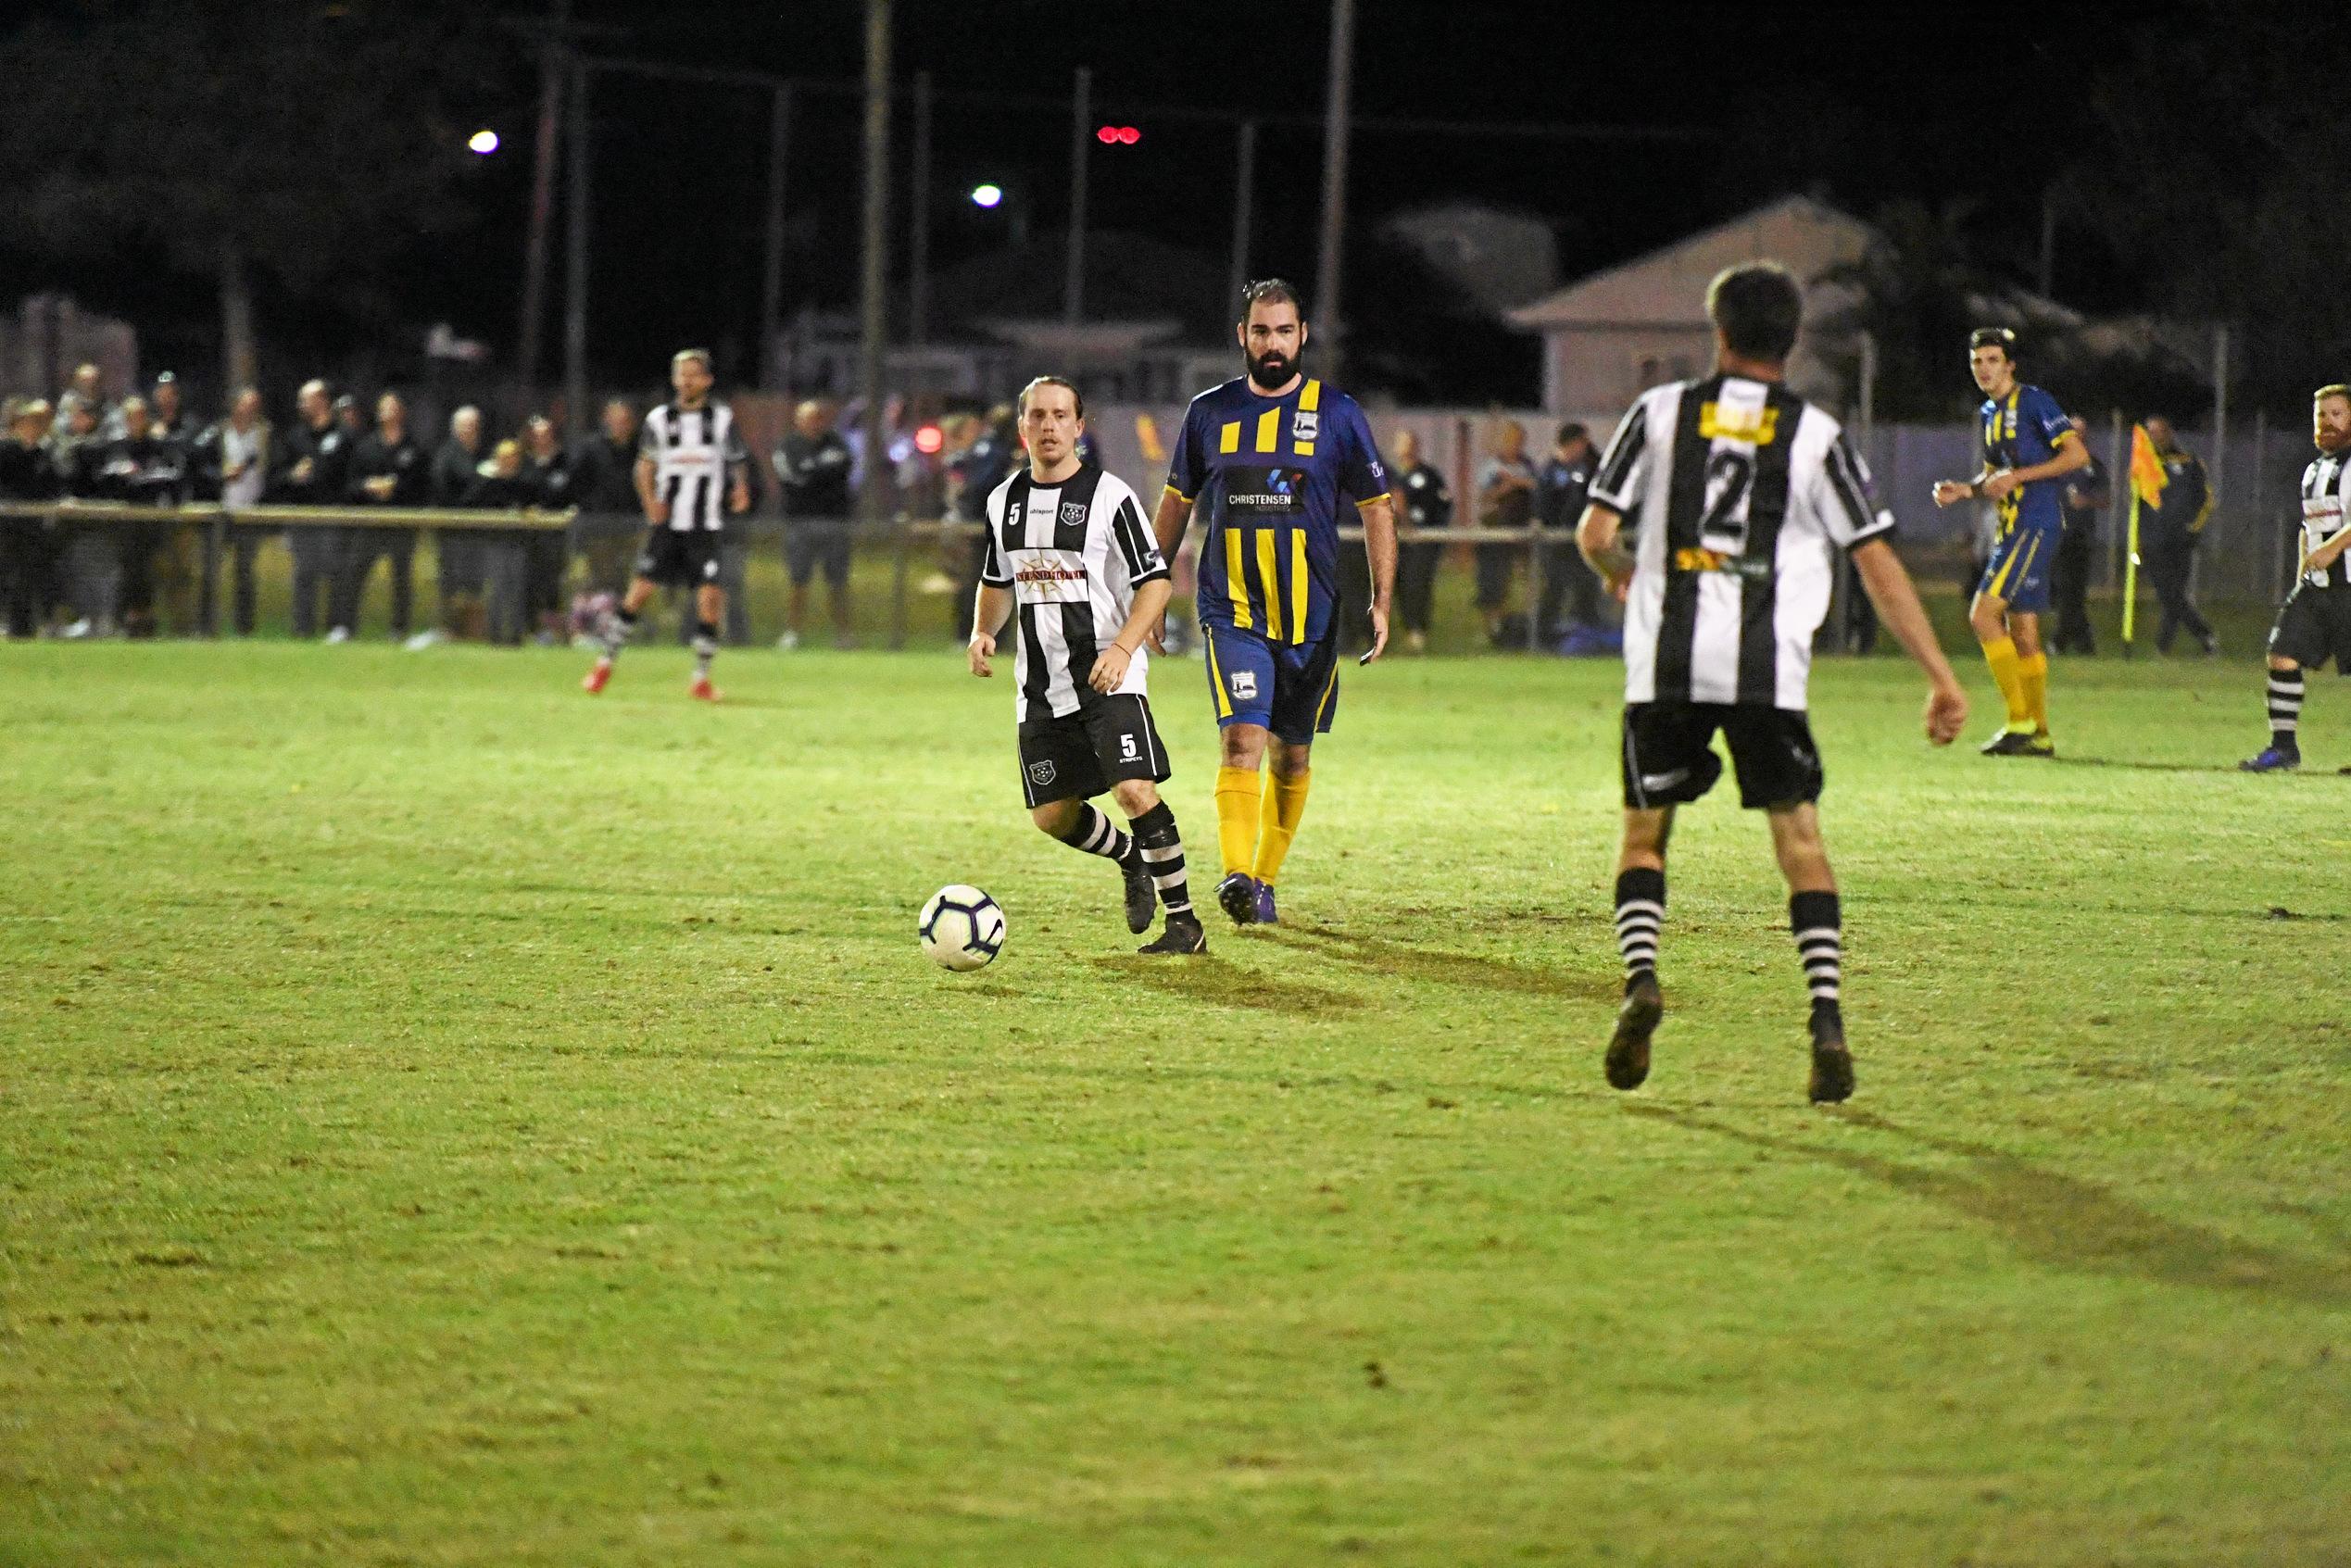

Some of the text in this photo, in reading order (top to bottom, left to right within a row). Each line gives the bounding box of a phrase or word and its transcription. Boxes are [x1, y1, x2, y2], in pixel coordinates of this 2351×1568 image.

[1229, 494, 1291, 505] CHRISTENSEN
[1701, 448, 1754, 538] 2
[1008, 502, 1021, 526] 5
[1120, 734, 1137, 757] 5
